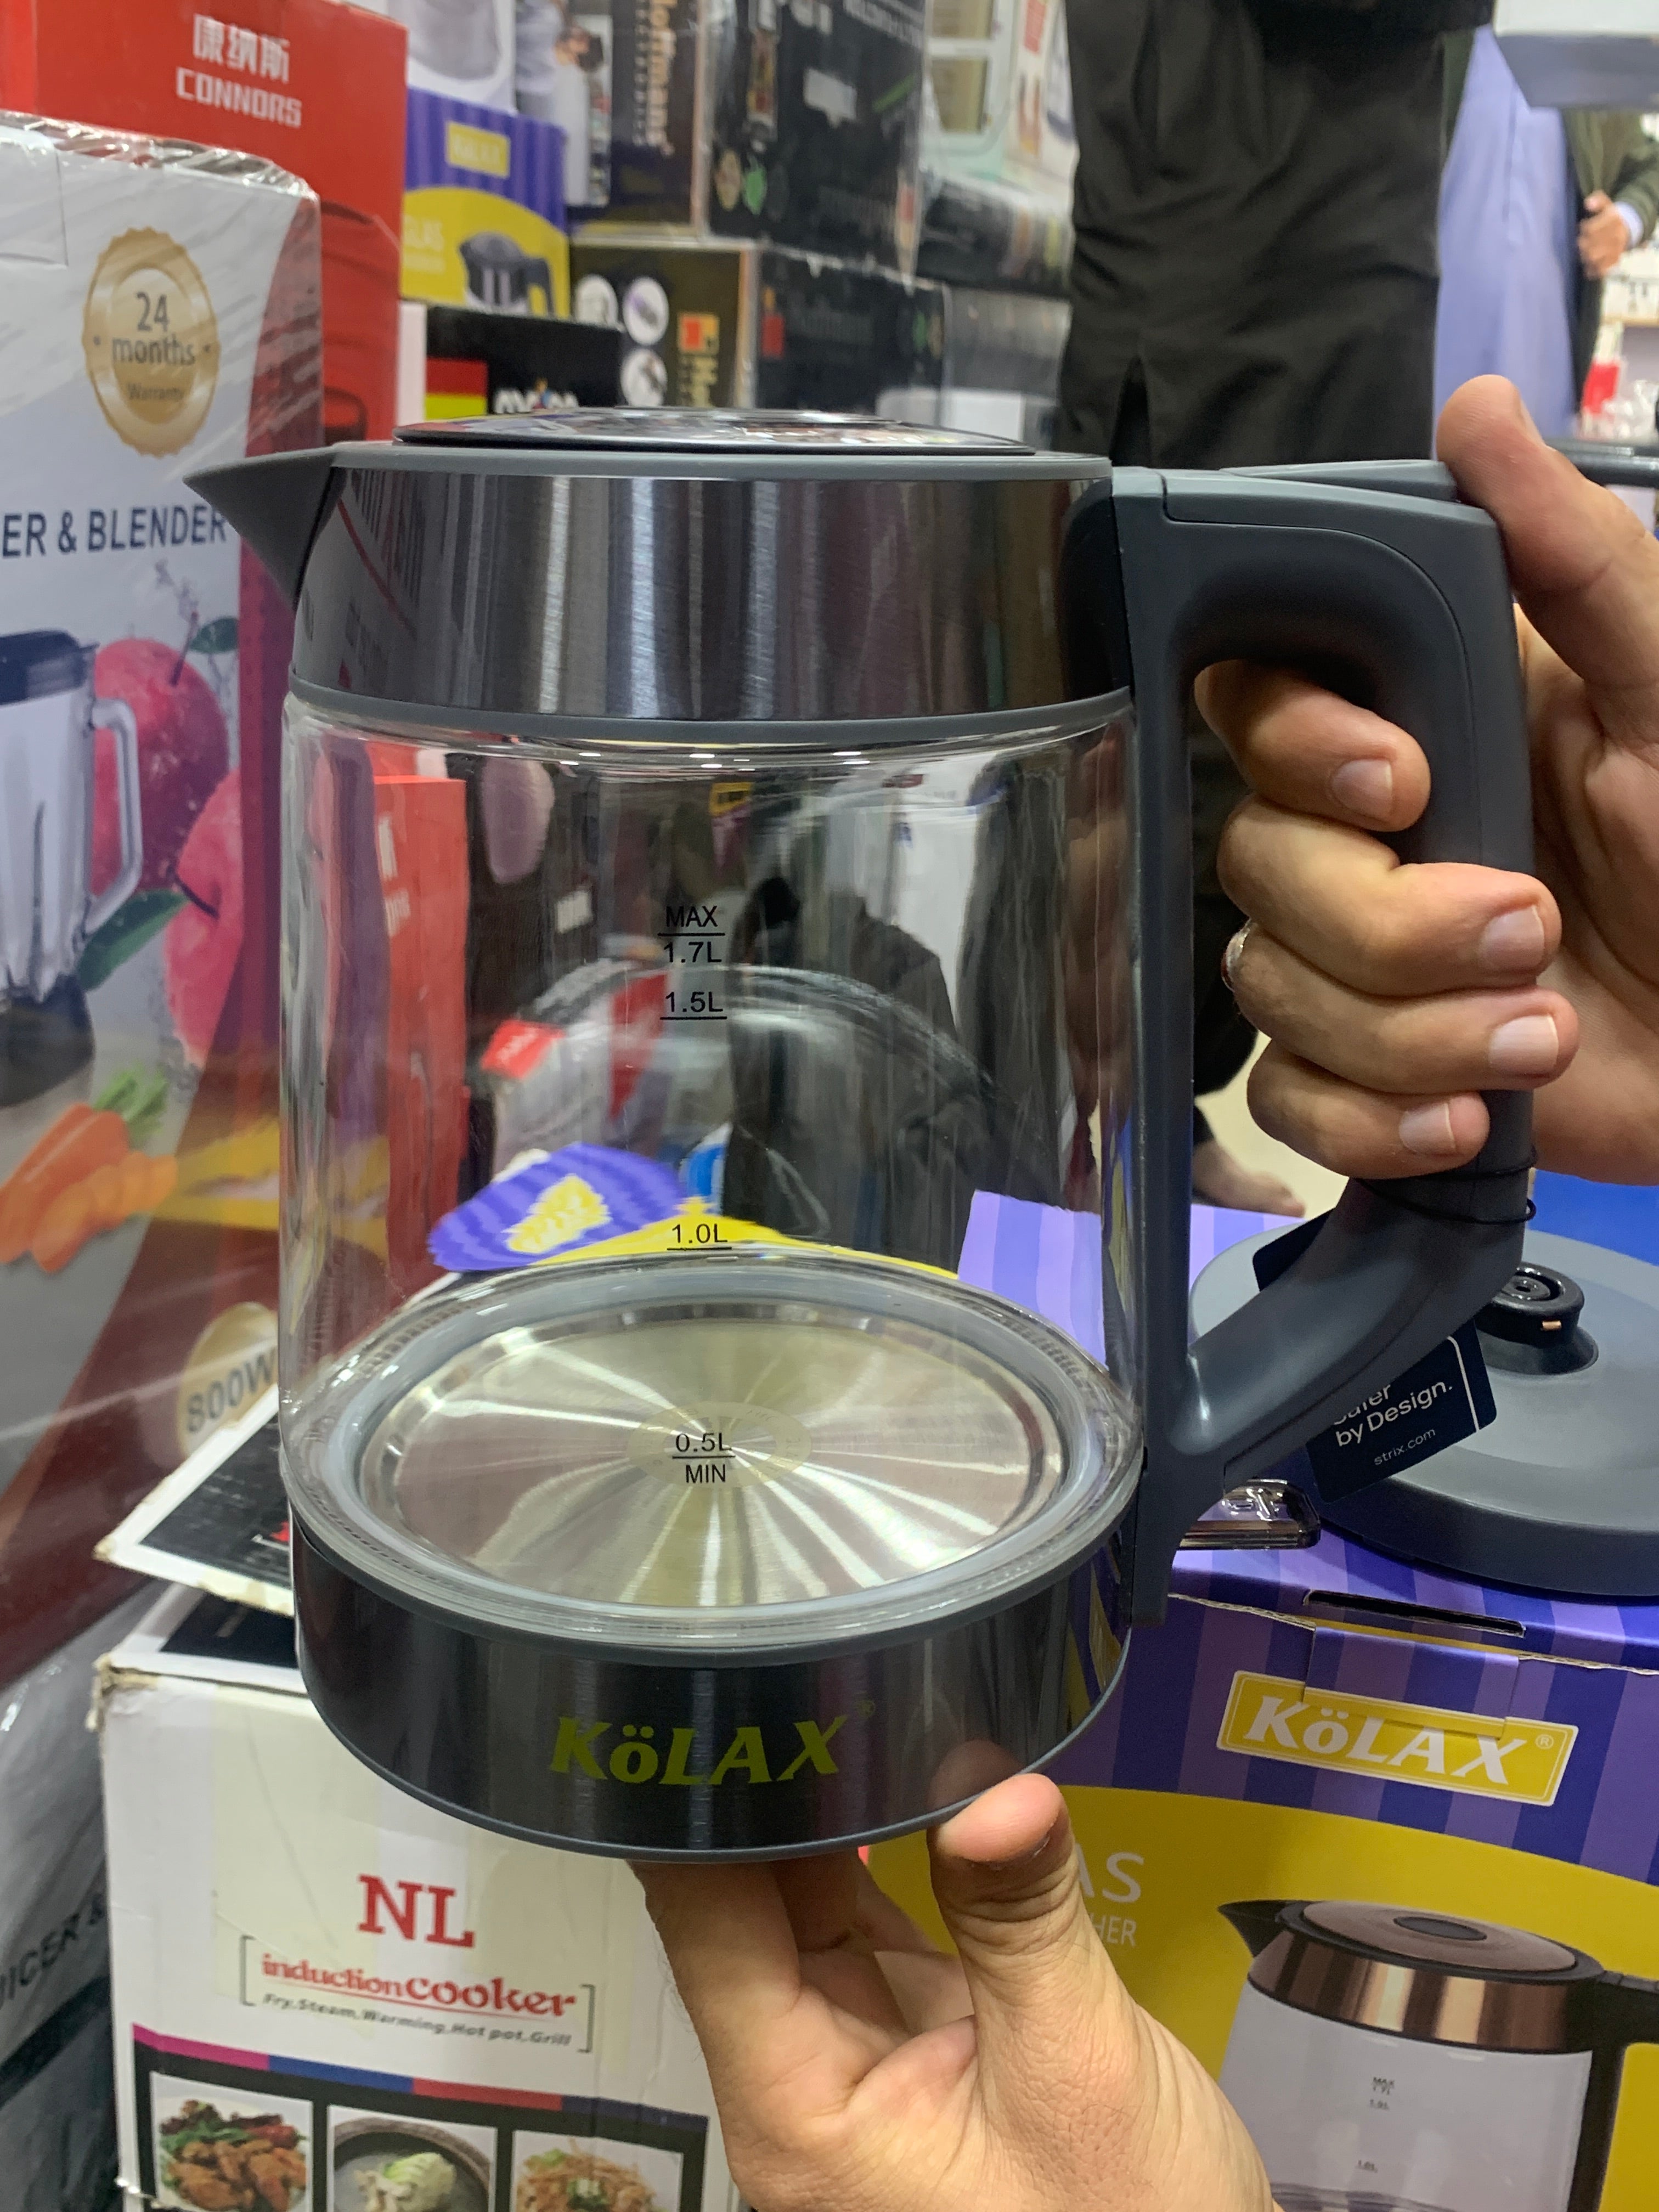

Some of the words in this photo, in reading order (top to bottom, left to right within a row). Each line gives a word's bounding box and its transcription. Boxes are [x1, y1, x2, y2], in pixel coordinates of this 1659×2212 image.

[176, 66, 302, 128] CONNORS
[135, 291, 171, 332] 24
[112, 334, 195, 366] months
[58, 510, 77, 554] &
[87, 505, 227, 552] BLENDER
[665, 906, 718, 928] MAX
[663, 941, 723, 963] 1.7L
[665, 991, 724, 1013] 1.5L
[672, 1223, 727, 1244] 1.0L
[1335, 1423, 1363, 1447] by
[1366, 1381, 1453, 1432] Design.
[675, 1433, 732, 1453] 0.5L
[1374, 1429, 1436, 1465] strix.com
[685, 1464, 726, 1483] MIN
[357, 1874, 475, 1948] NL
